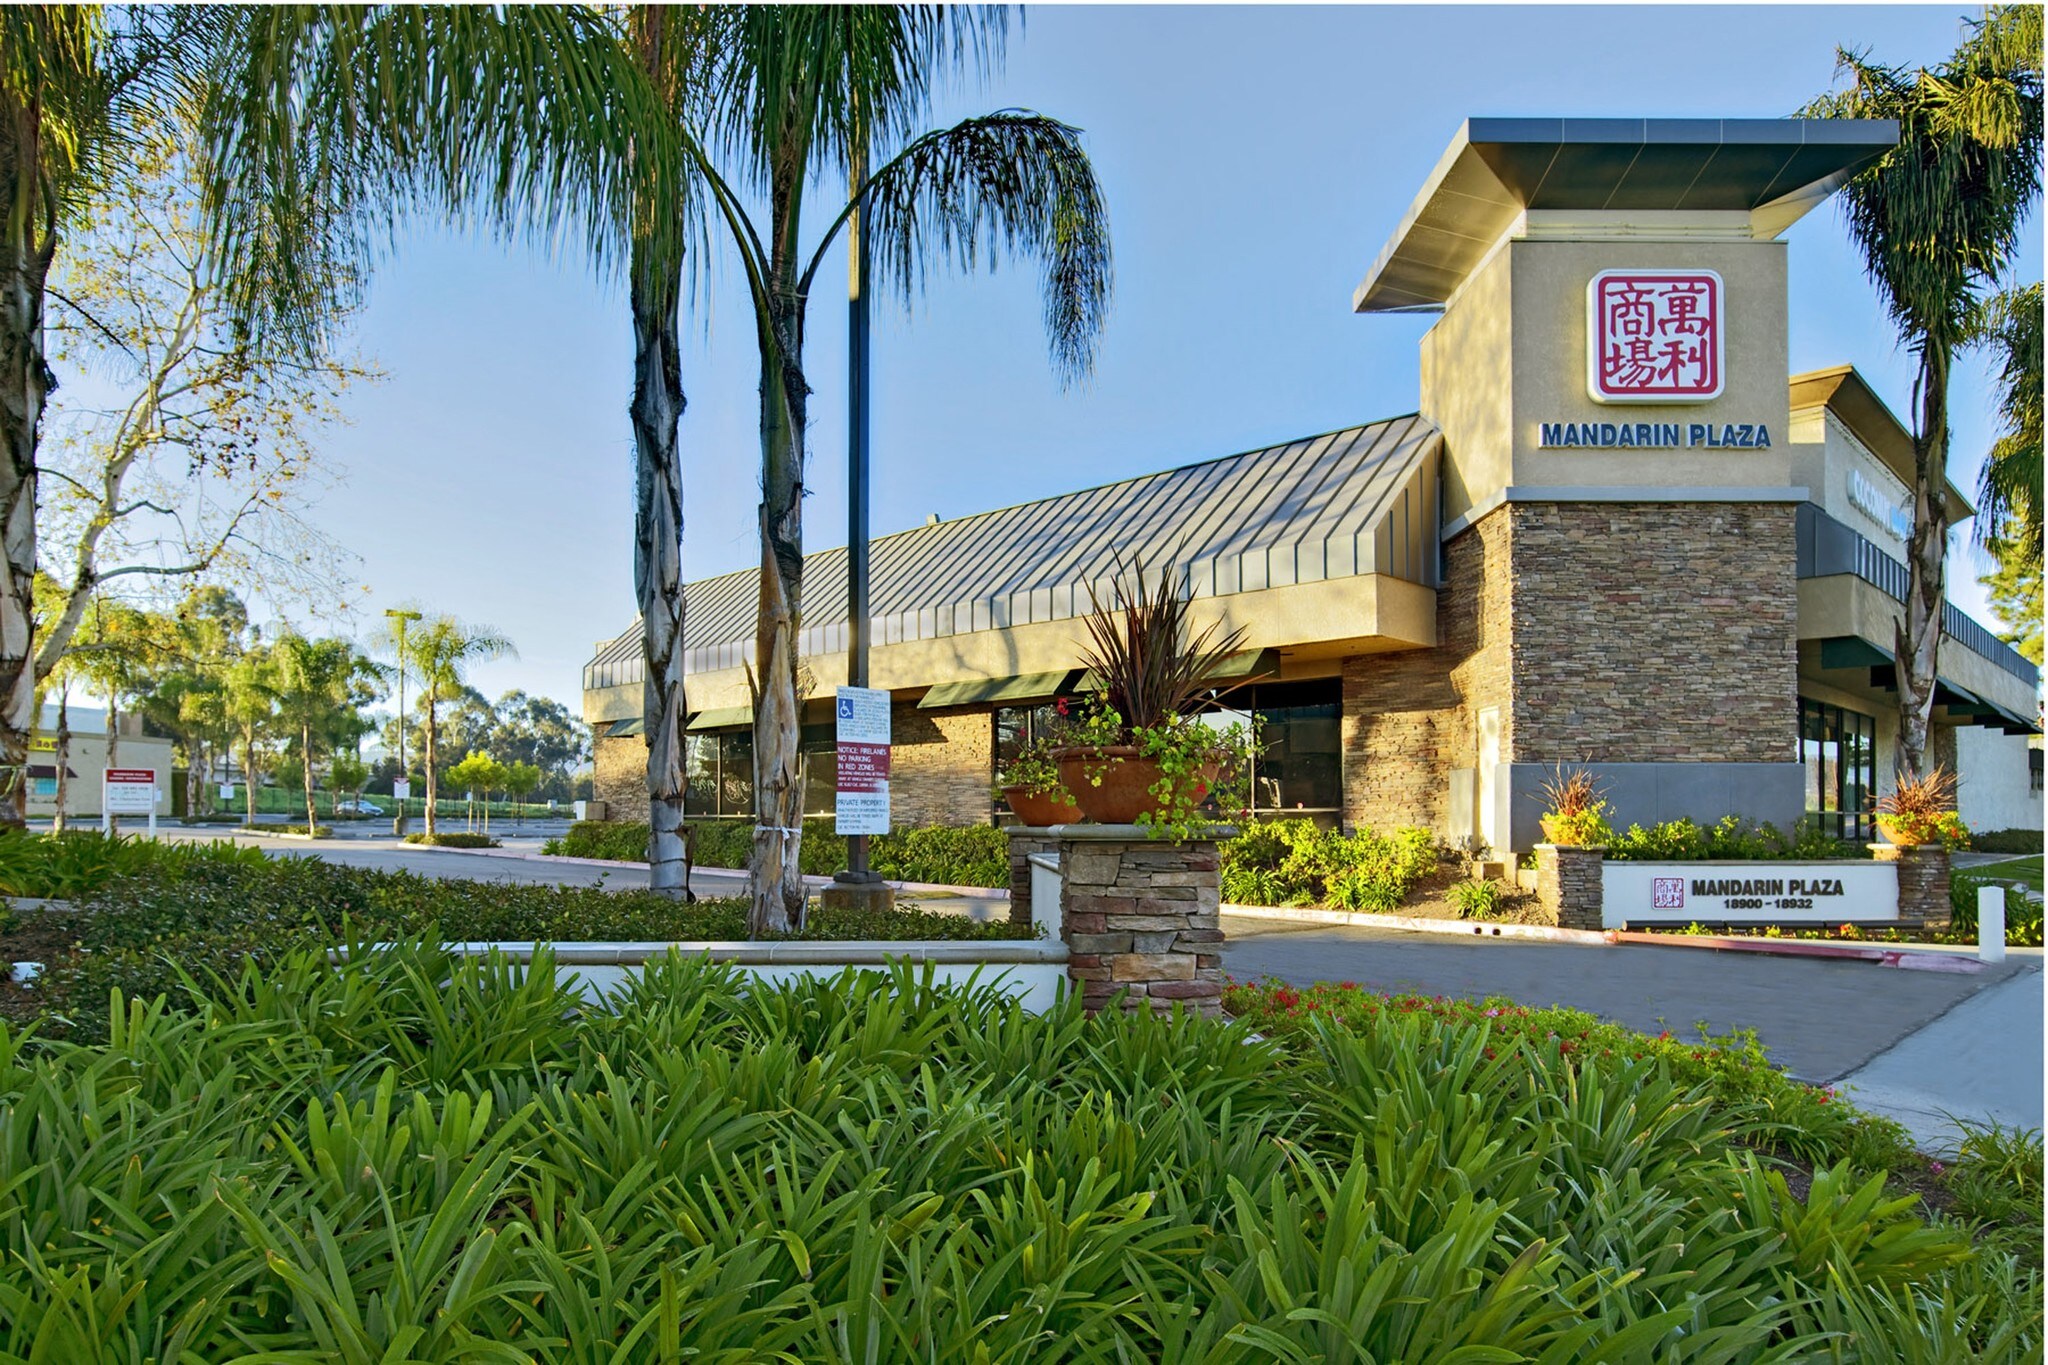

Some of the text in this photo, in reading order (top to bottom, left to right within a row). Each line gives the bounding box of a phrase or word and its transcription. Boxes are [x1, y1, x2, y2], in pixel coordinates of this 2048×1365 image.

[1539, 423, 1771, 448] MANDARIN PLAZA
[848, 755, 871, 763] PARKING
[1692, 880, 1783, 896] MANDARIN
[1789, 880, 1844, 896] PLAZA
[1724, 899, 1763, 909] 18900
[1775, 899, 1813, 909] 18932
